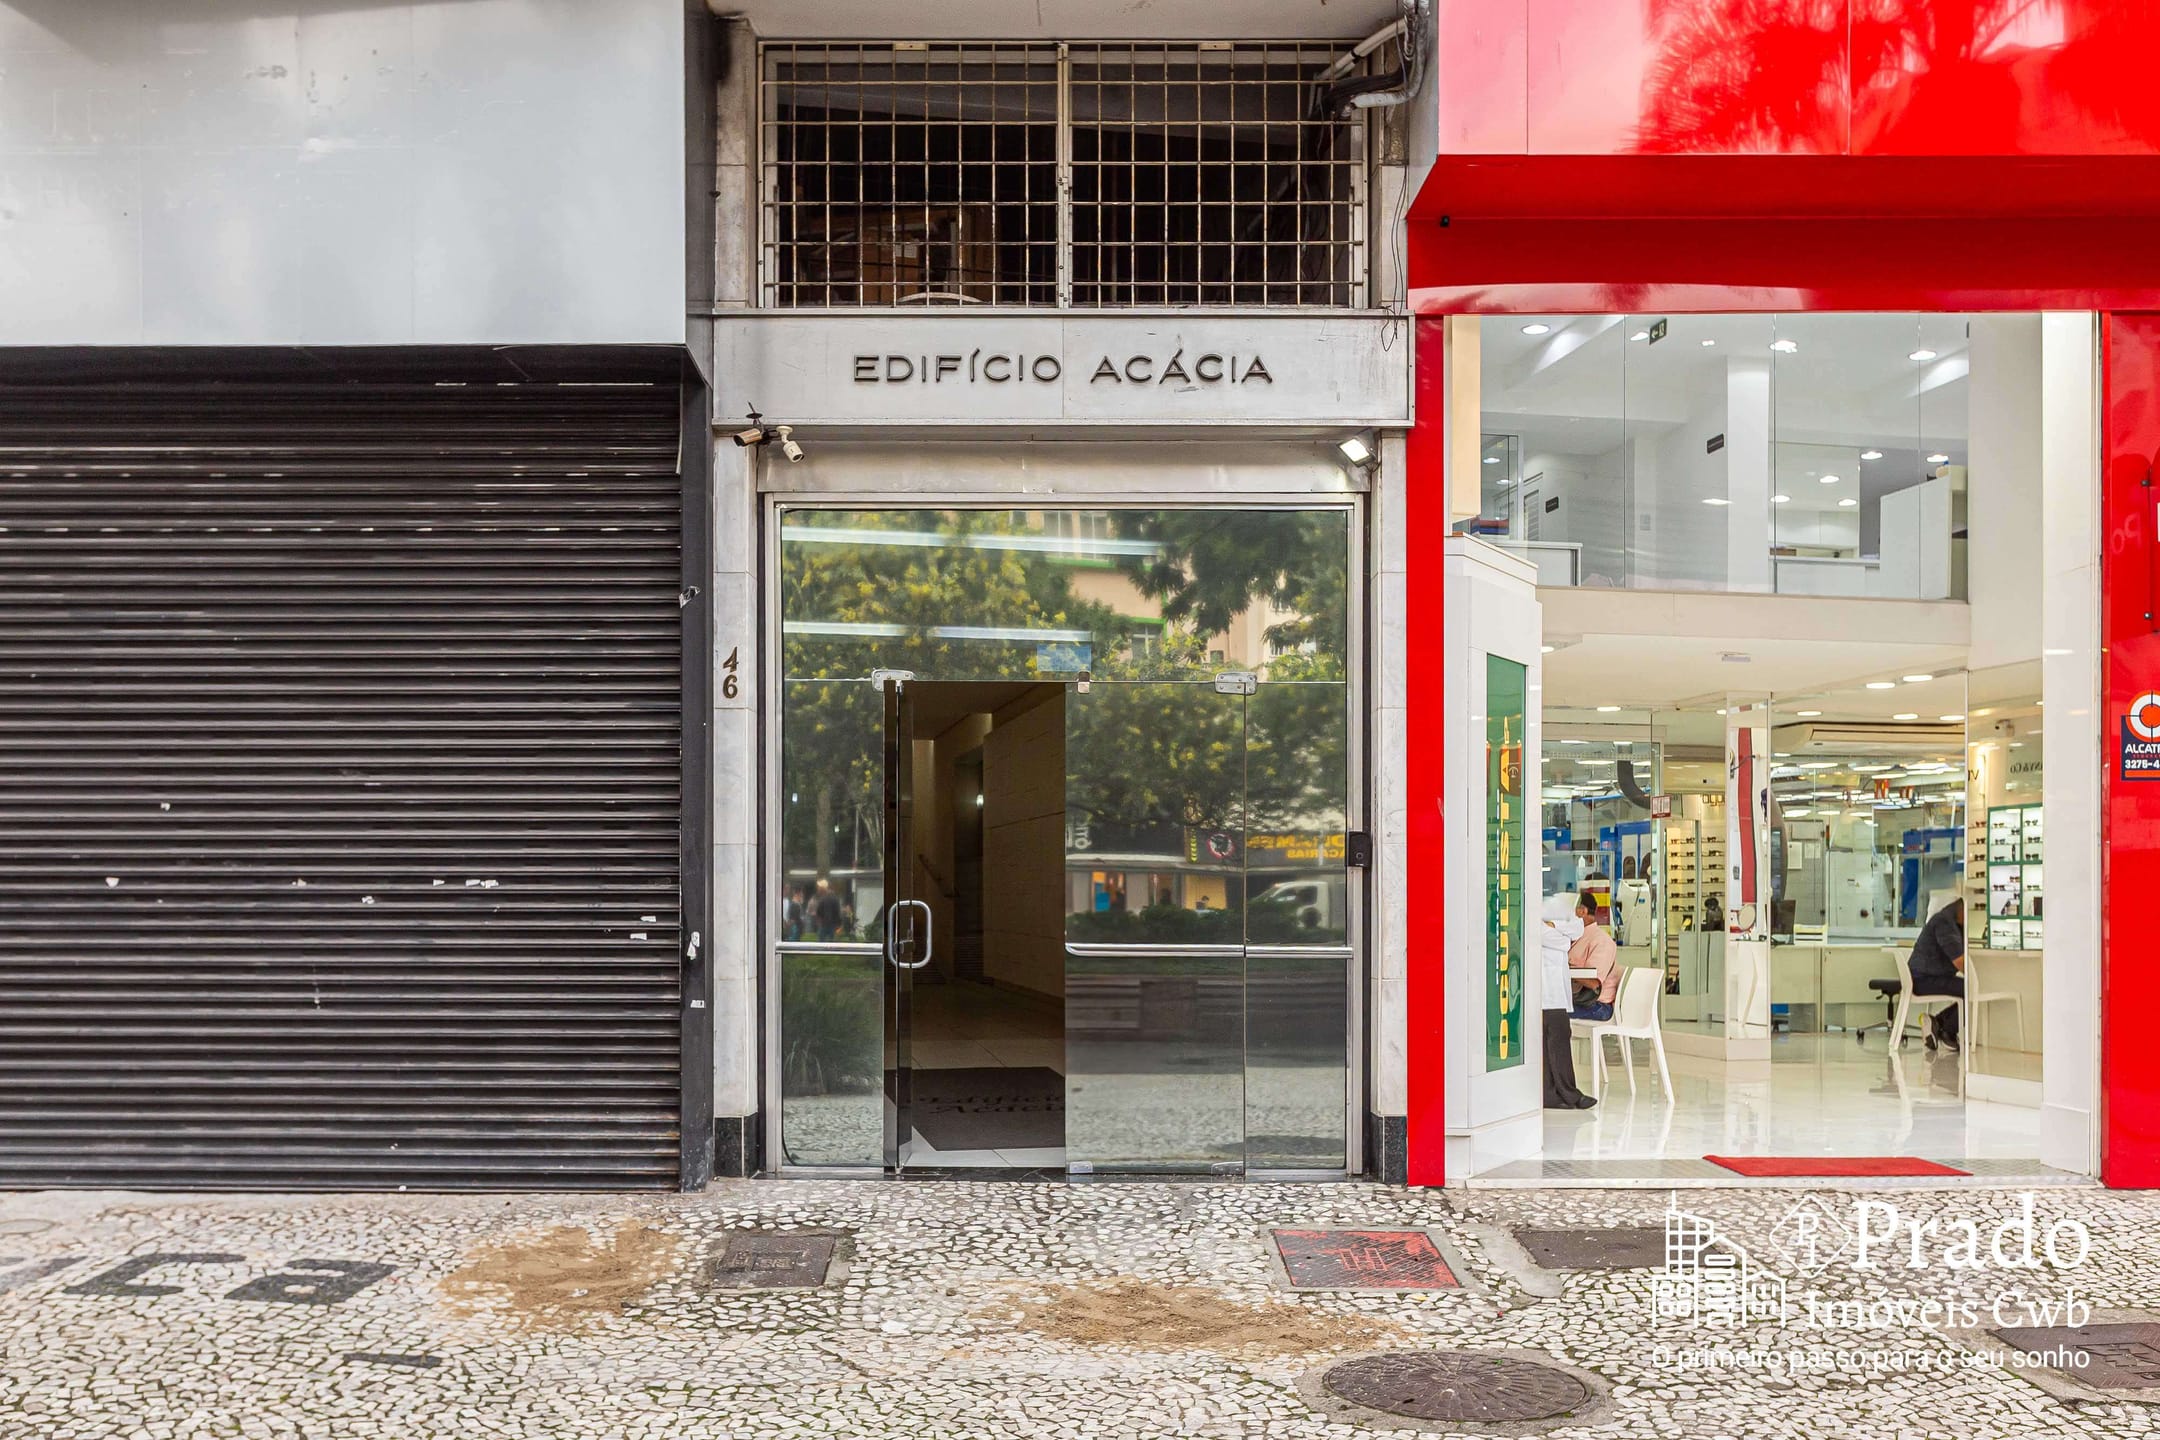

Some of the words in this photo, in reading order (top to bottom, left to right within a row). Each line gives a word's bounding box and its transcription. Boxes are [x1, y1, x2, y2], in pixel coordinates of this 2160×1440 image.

[853, 348, 1062, 383] EDIFÍCIO
[1090, 348, 1273, 384] ACÁCIA
[723, 646, 738, 699] 46
